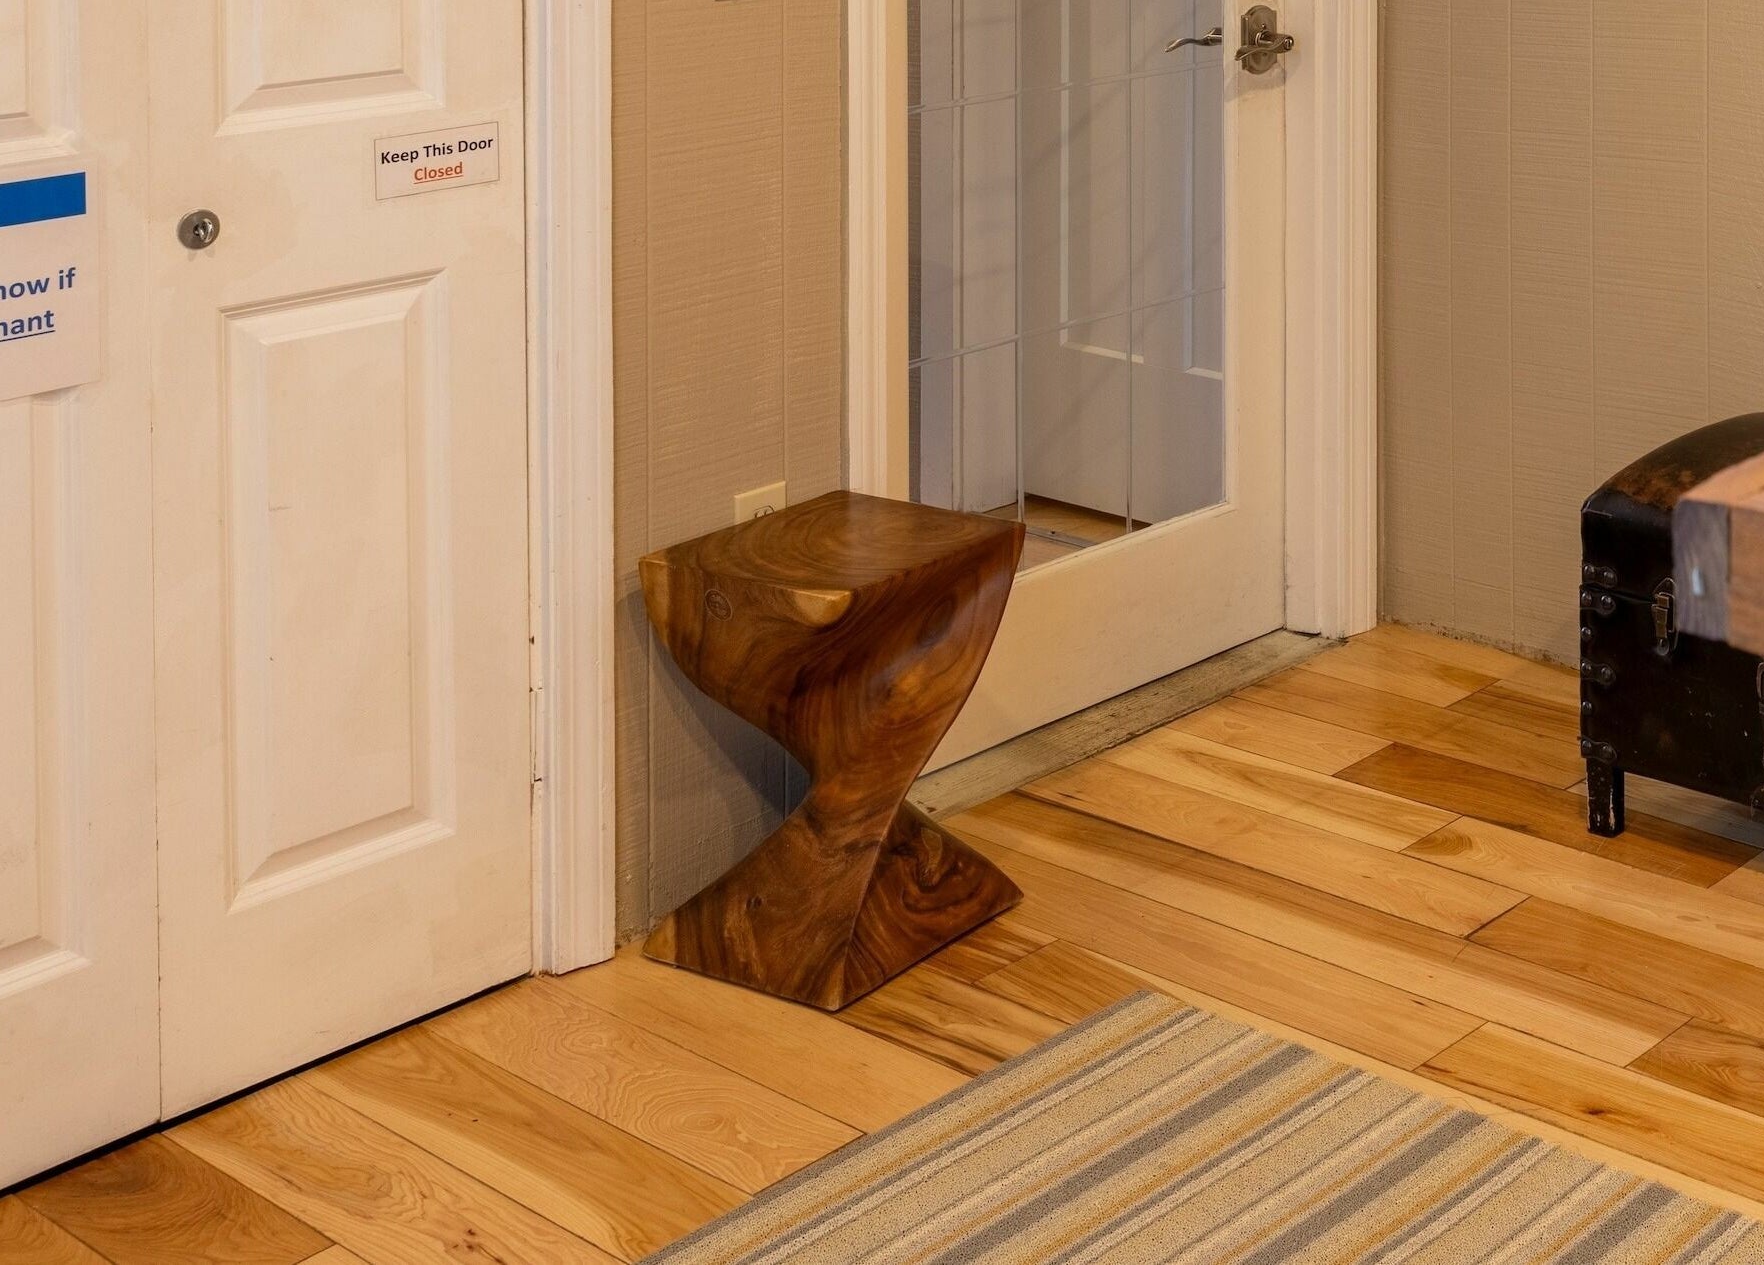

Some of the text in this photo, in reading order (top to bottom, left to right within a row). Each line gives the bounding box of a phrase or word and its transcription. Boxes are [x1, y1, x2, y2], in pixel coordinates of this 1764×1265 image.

[380, 138, 494, 165] Keep This Door
[413, 161, 464, 182] Closed
[58, 266, 76, 290] if
